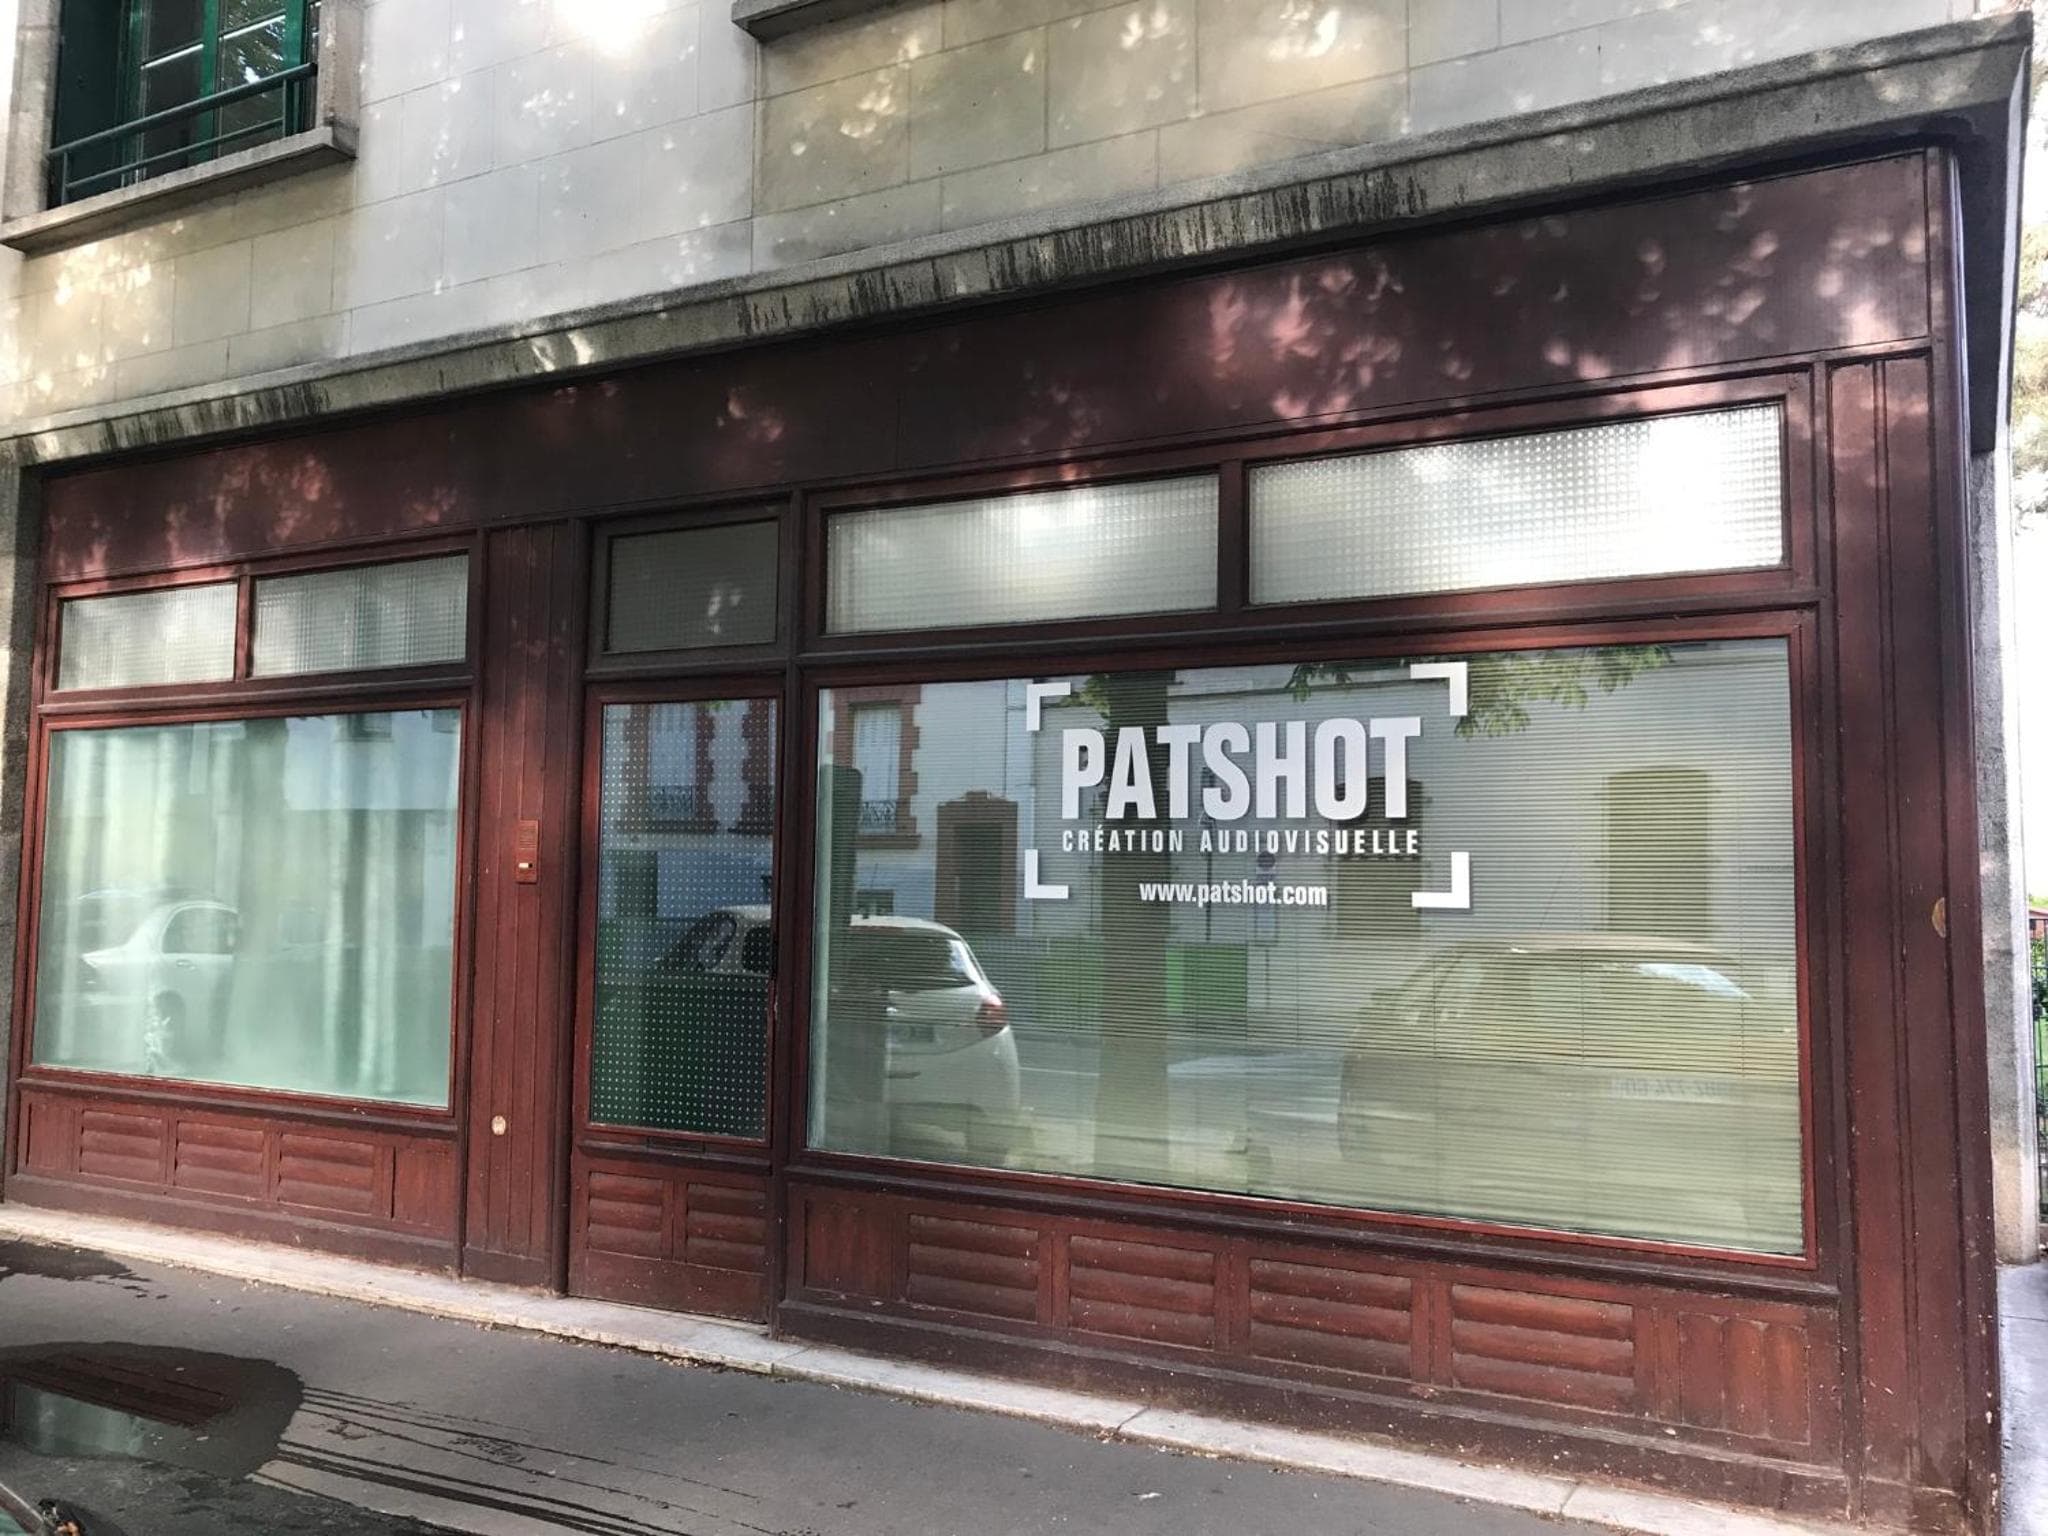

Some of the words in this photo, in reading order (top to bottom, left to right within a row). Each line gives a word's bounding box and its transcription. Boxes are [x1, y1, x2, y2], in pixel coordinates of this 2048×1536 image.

[1062, 717, 1421, 821] PATSHOT
[1062, 825, 1183, 853] CRÉATION
[1200, 829, 1418, 854] AUDIOVISUELLE
[1139, 879, 1328, 908] www.patshot.com
